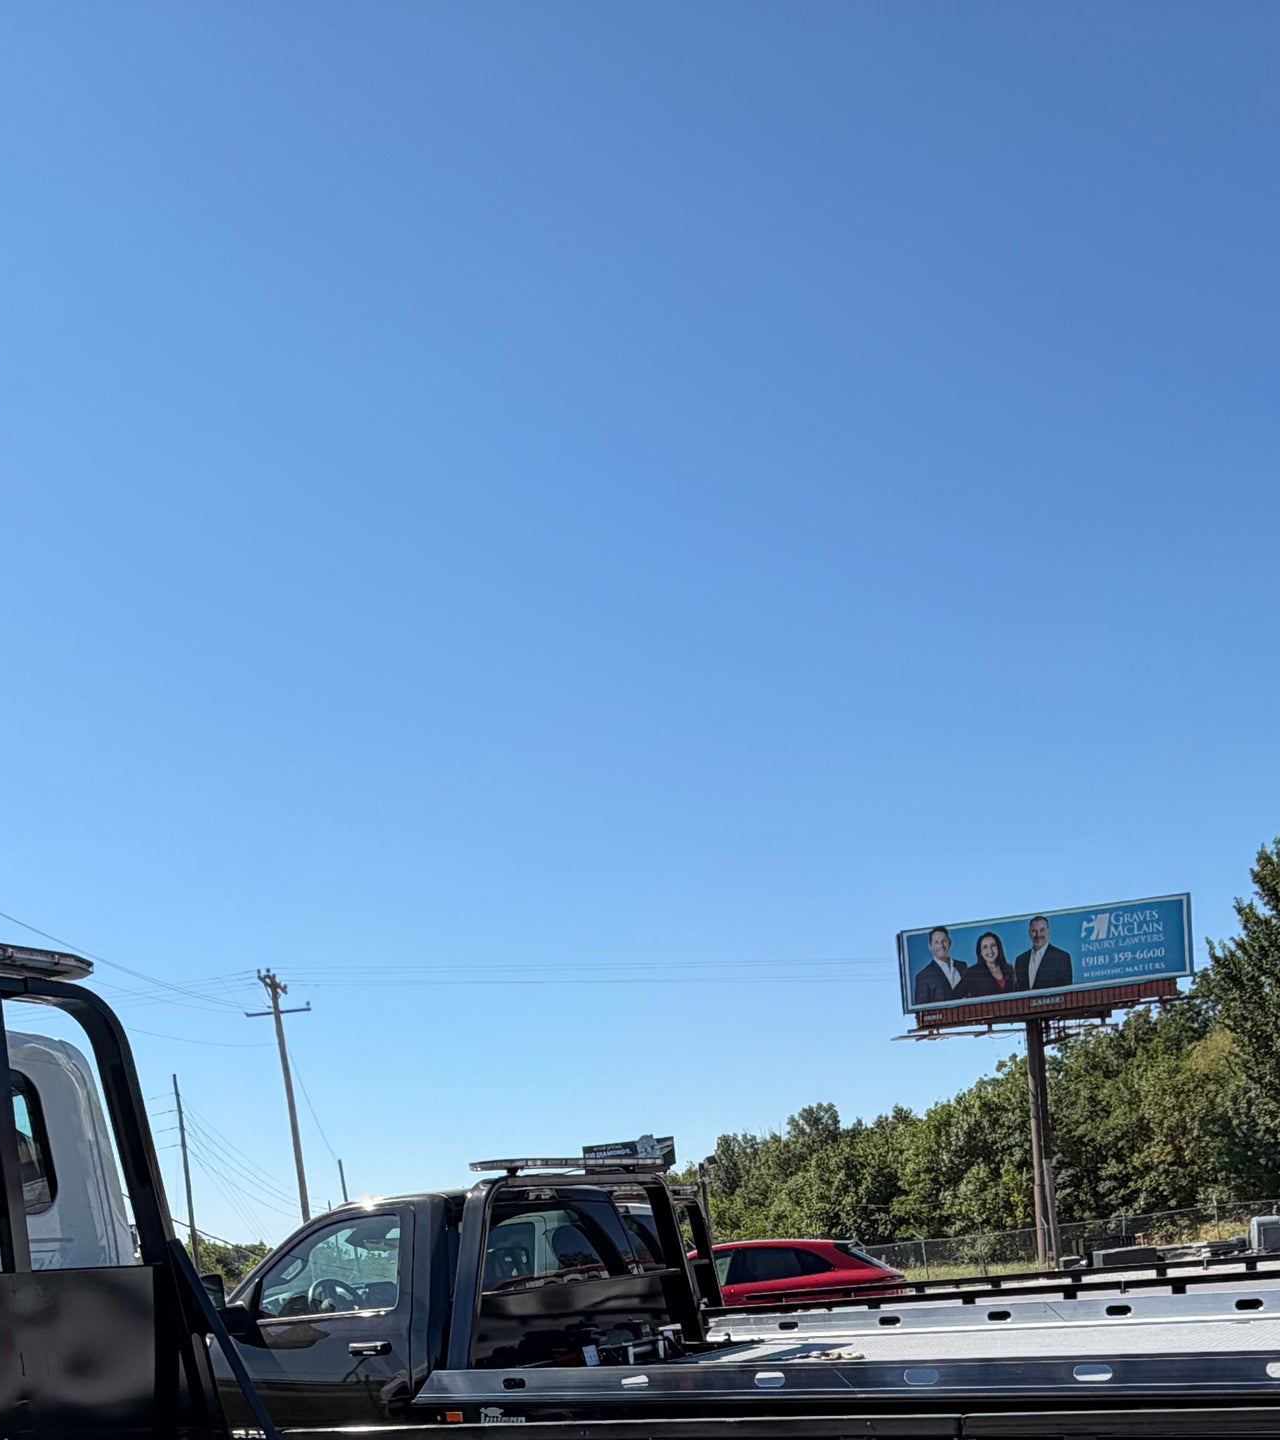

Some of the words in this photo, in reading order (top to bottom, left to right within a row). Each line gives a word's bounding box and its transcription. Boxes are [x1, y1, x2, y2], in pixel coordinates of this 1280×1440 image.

[1081, 940, 1116, 952] INJURY
[1119, 933, 1165, 947] LAWYERS
[1081, 954, 1109, 967] (918)
